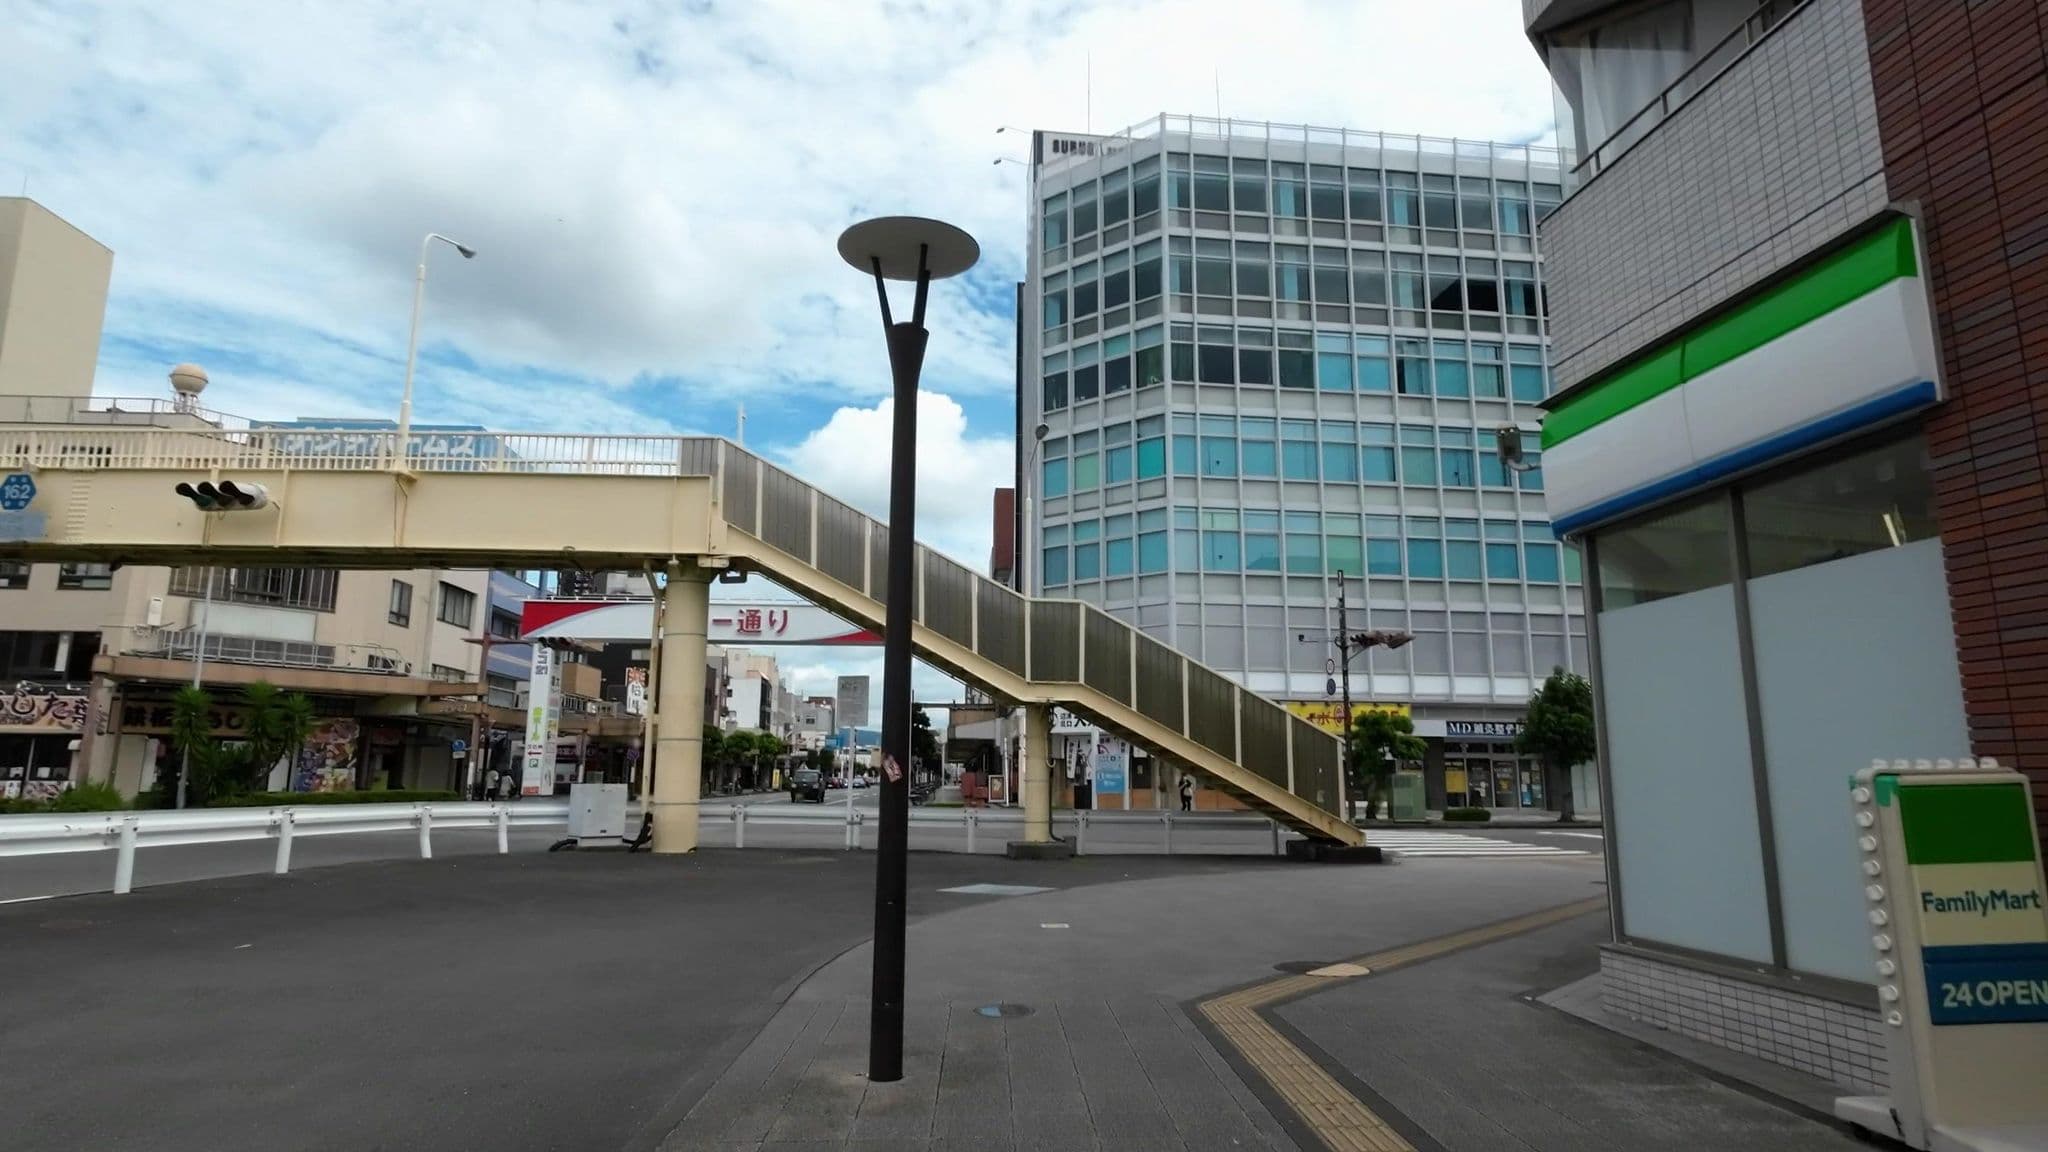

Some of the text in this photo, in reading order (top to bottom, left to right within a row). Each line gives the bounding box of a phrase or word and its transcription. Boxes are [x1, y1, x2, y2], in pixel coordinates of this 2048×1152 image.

[4, 484, 31, 499] 162
[1921, 889, 2041, 917] FamilyMart
[1941, 980, 2048, 1008] 24 OPEN
